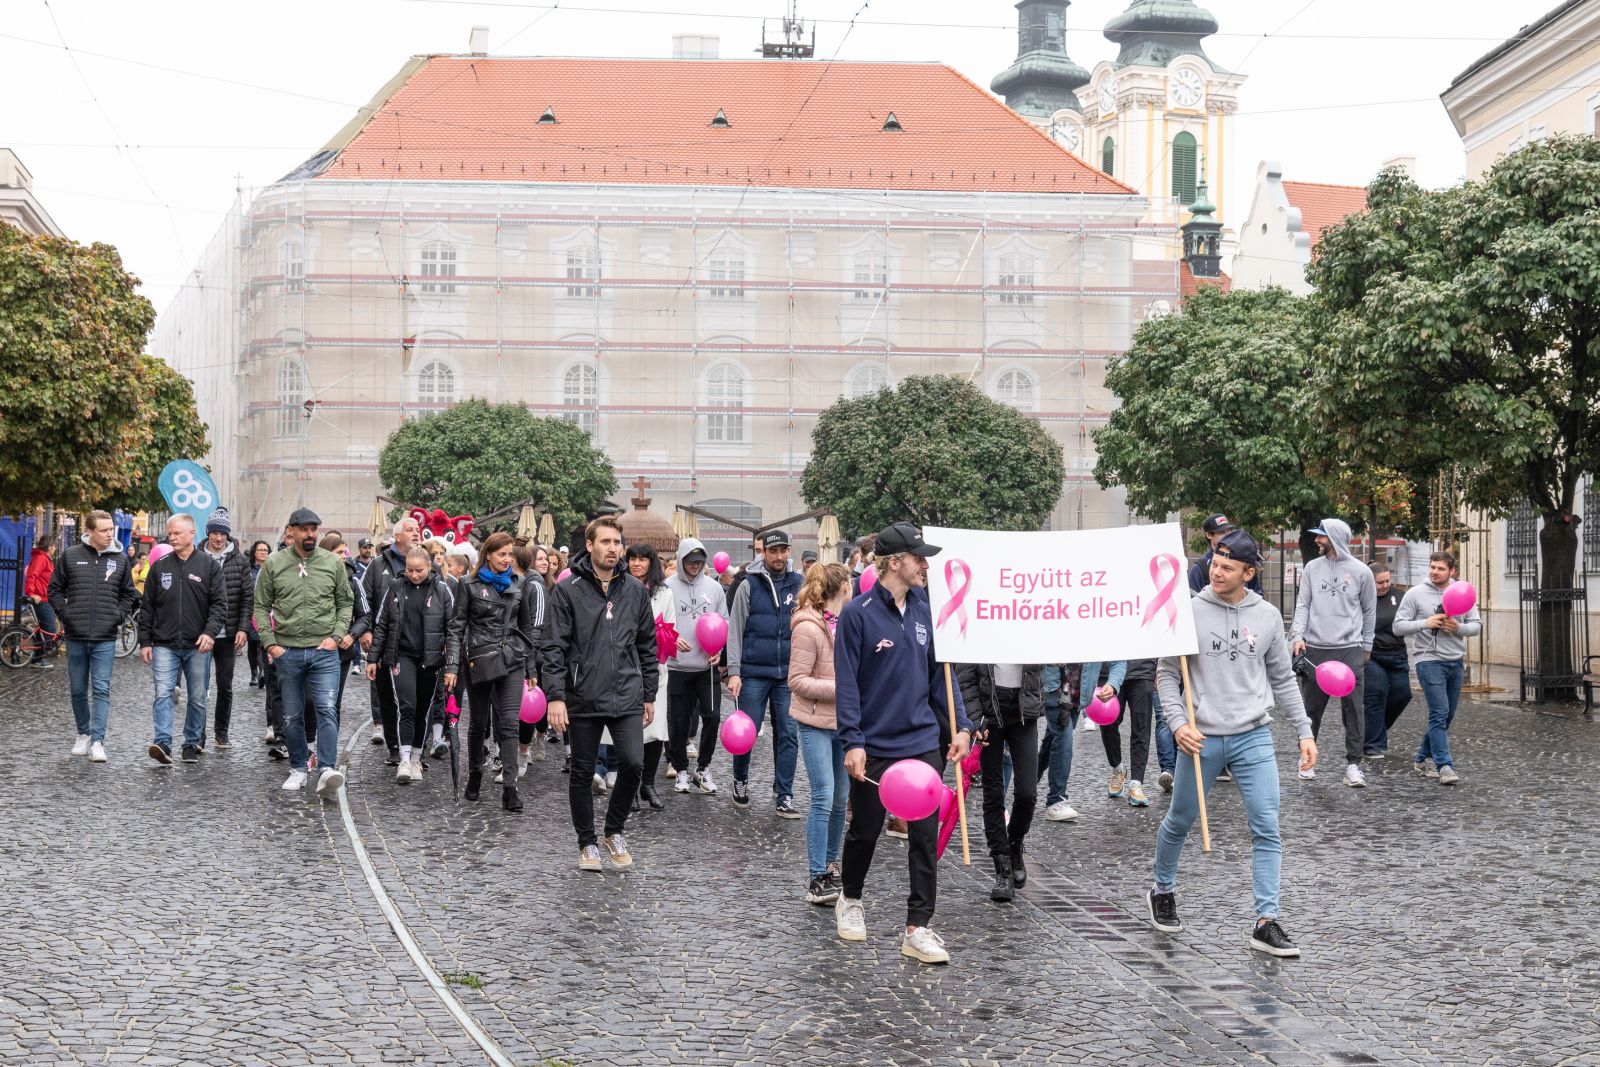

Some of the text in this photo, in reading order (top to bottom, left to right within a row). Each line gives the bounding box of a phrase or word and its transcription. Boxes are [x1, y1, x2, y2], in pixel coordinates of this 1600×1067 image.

[1000, 568, 1107, 594] Együtt az
[976, 596, 1140, 620] Emlőrák ellen!
[1231, 630, 1238, 639] N
[1212, 640, 1221, 650] W
[1230, 651, 1236, 660] S
